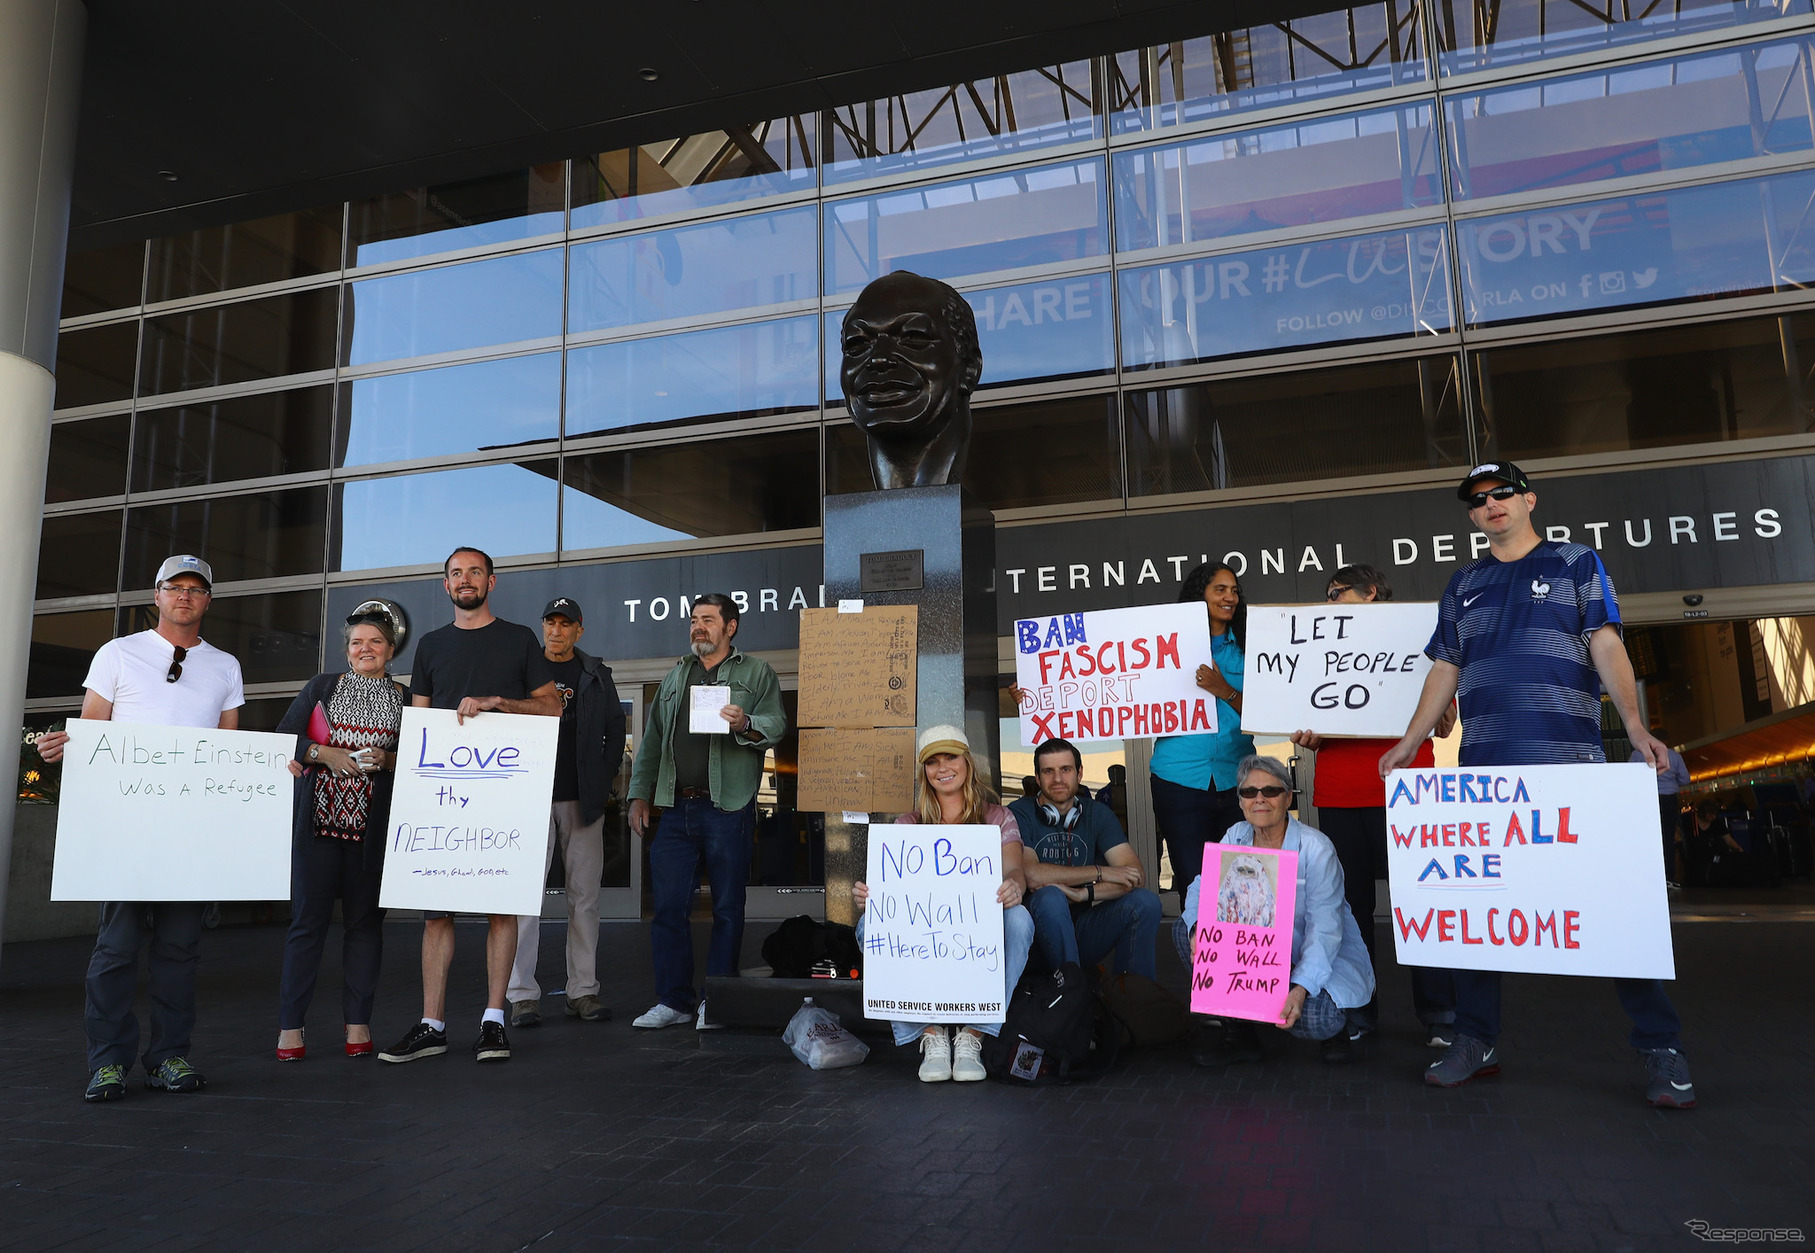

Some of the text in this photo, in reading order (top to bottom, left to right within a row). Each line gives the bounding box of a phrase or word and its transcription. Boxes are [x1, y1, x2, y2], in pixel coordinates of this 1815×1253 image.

[1277, 308, 1364, 333] FOLLOW
[1531, 282, 1566, 301] ON
[624, 594, 702, 623] TOM
[1392, 508, 1783, 565] DEPRTURES
[1017, 612, 1088, 654] BAN
[1038, 632, 1181, 685] FASCISM
[1324, 651, 1420, 676] PEOPLE
[1020, 674, 1141, 715] DEPORT
[1031, 699, 1211, 745] XENOPHOBIA
[89, 733, 287, 769] Albet Einstein
[418, 727, 520, 769] Love
[119, 778, 277, 802] Was A Refugee
[436, 786, 469, 808] thy
[1388, 773, 1531, 808] AMERICA
[1390, 807, 1579, 849] WHERE ALL
[881, 838, 993, 882] NO Ban
[1417, 854, 1501, 882] ARE
[869, 892, 978, 928] NO Wall
[1394, 907, 1580, 949] WELCOME
[1199, 926, 1275, 947] NO BAN
[1236, 949, 1281, 968] WALL
[1226, 971, 1280, 994] TRUMP
[867, 999, 1001, 1012] UNITED SERVICE WORKERS WEST
